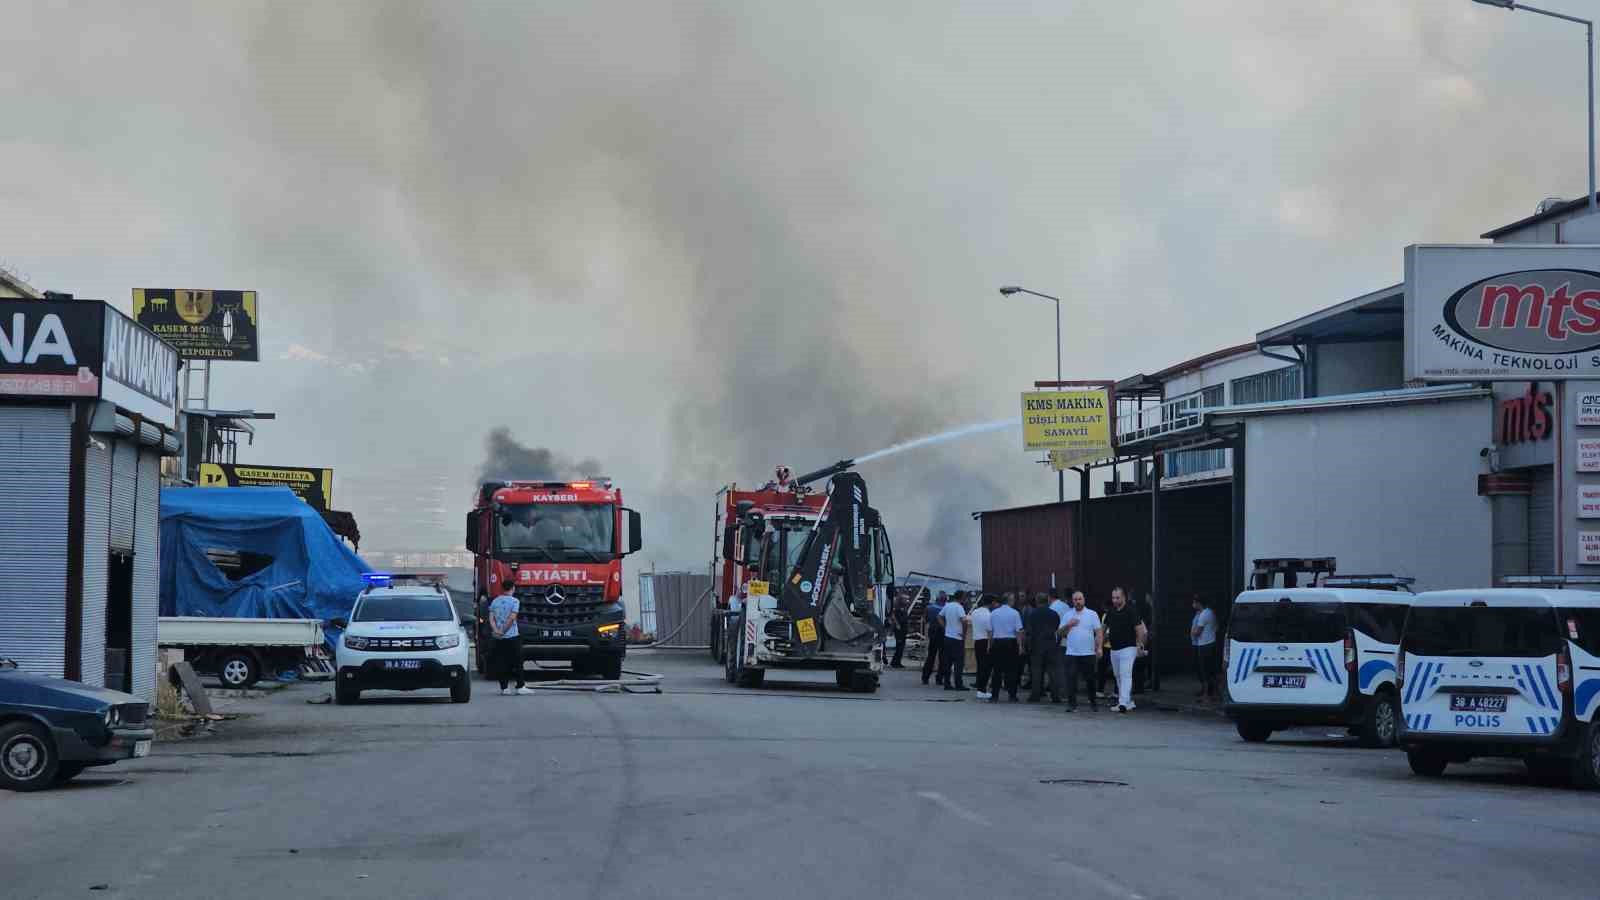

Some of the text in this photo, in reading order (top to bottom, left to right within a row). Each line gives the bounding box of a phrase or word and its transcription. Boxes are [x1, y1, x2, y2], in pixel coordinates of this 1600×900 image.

[152, 324, 188, 333] KASEM
[106, 313, 128, 381] AK
[1432, 323, 1484, 361] MAKİNA
[1493, 352, 1579, 370] TEKNOLOJİ
[1026, 397, 1104, 410] KMS MAKİNA
[239, 470, 270, 479] KASEM
